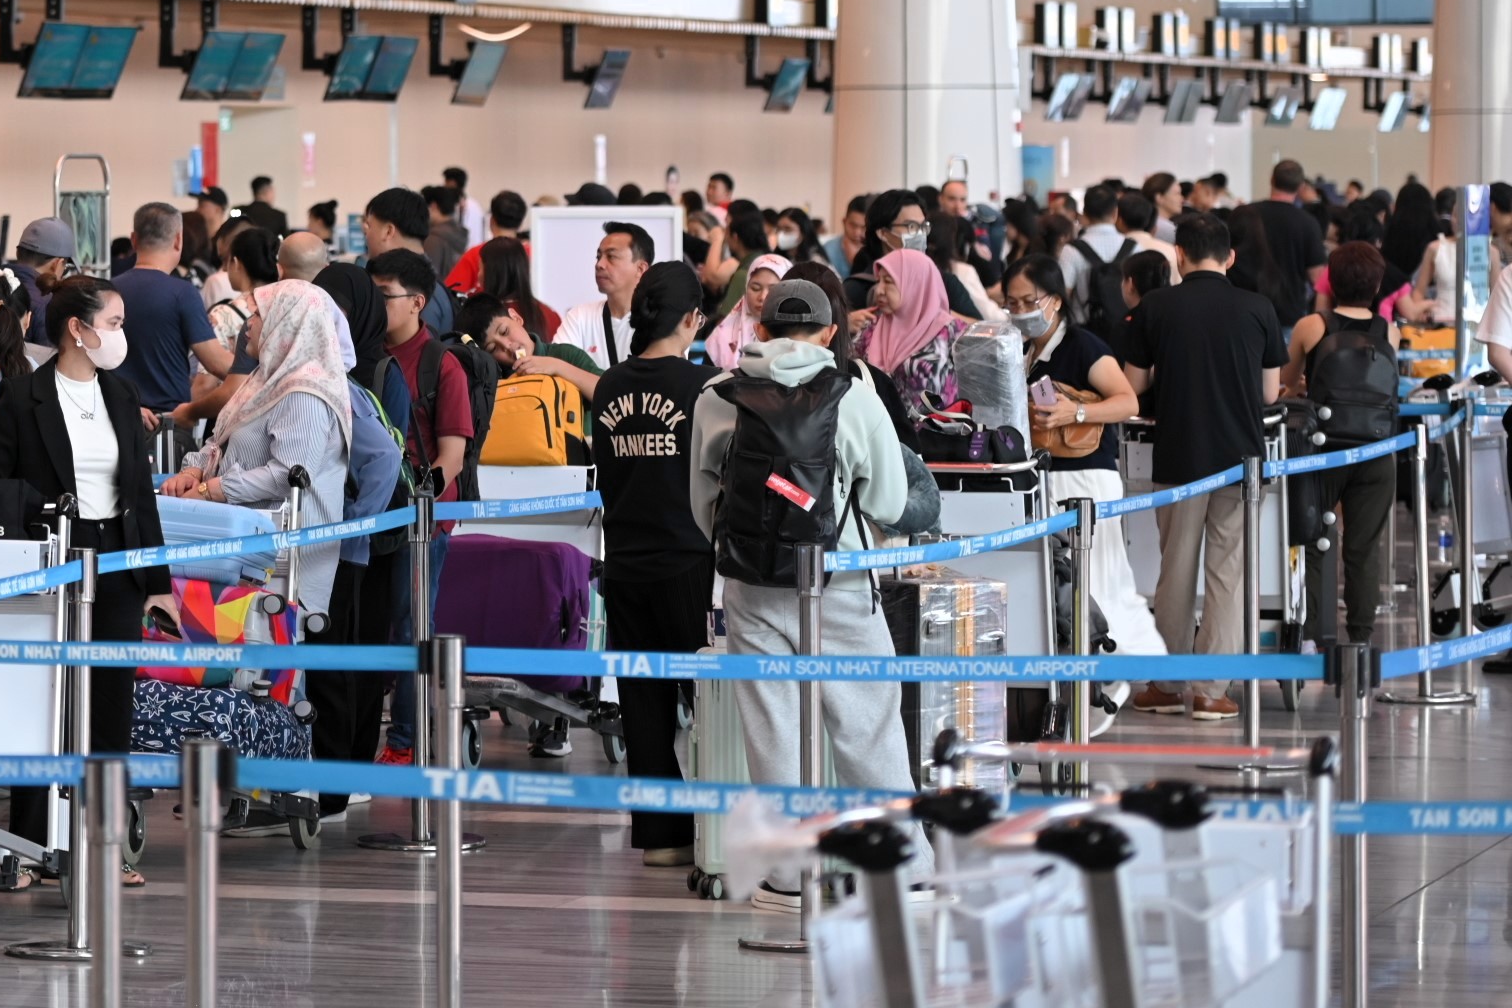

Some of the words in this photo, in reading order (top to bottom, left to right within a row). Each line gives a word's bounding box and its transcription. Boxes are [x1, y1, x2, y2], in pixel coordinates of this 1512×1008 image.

[599, 393, 633, 431] NEW
[642, 392, 686, 431] YORK
[610, 433, 676, 456] YANKEES
[472, 502, 486, 518] TIA
[271, 532, 289, 549] TIA
[125, 549, 143, 567] TIA
[22, 645, 61, 659] NHAT
[64, 646, 178, 661] INTERNATIONAL
[181, 647, 242, 661] AIRPORT
[600, 653, 654, 676] TIA
[758, 660, 792, 674] TAN
[793, 660, 833, 675] SON
[834, 660, 881, 675] NHAT
[883, 661, 1017, 675] INTERNATIONAL
[1021, 661, 1099, 676] AIRPORT
[21, 760, 73, 777] NHAT
[424, 768, 504, 802] TIA
[1409, 808, 1450, 828] TAN
[1457, 808, 1497, 827] SON
